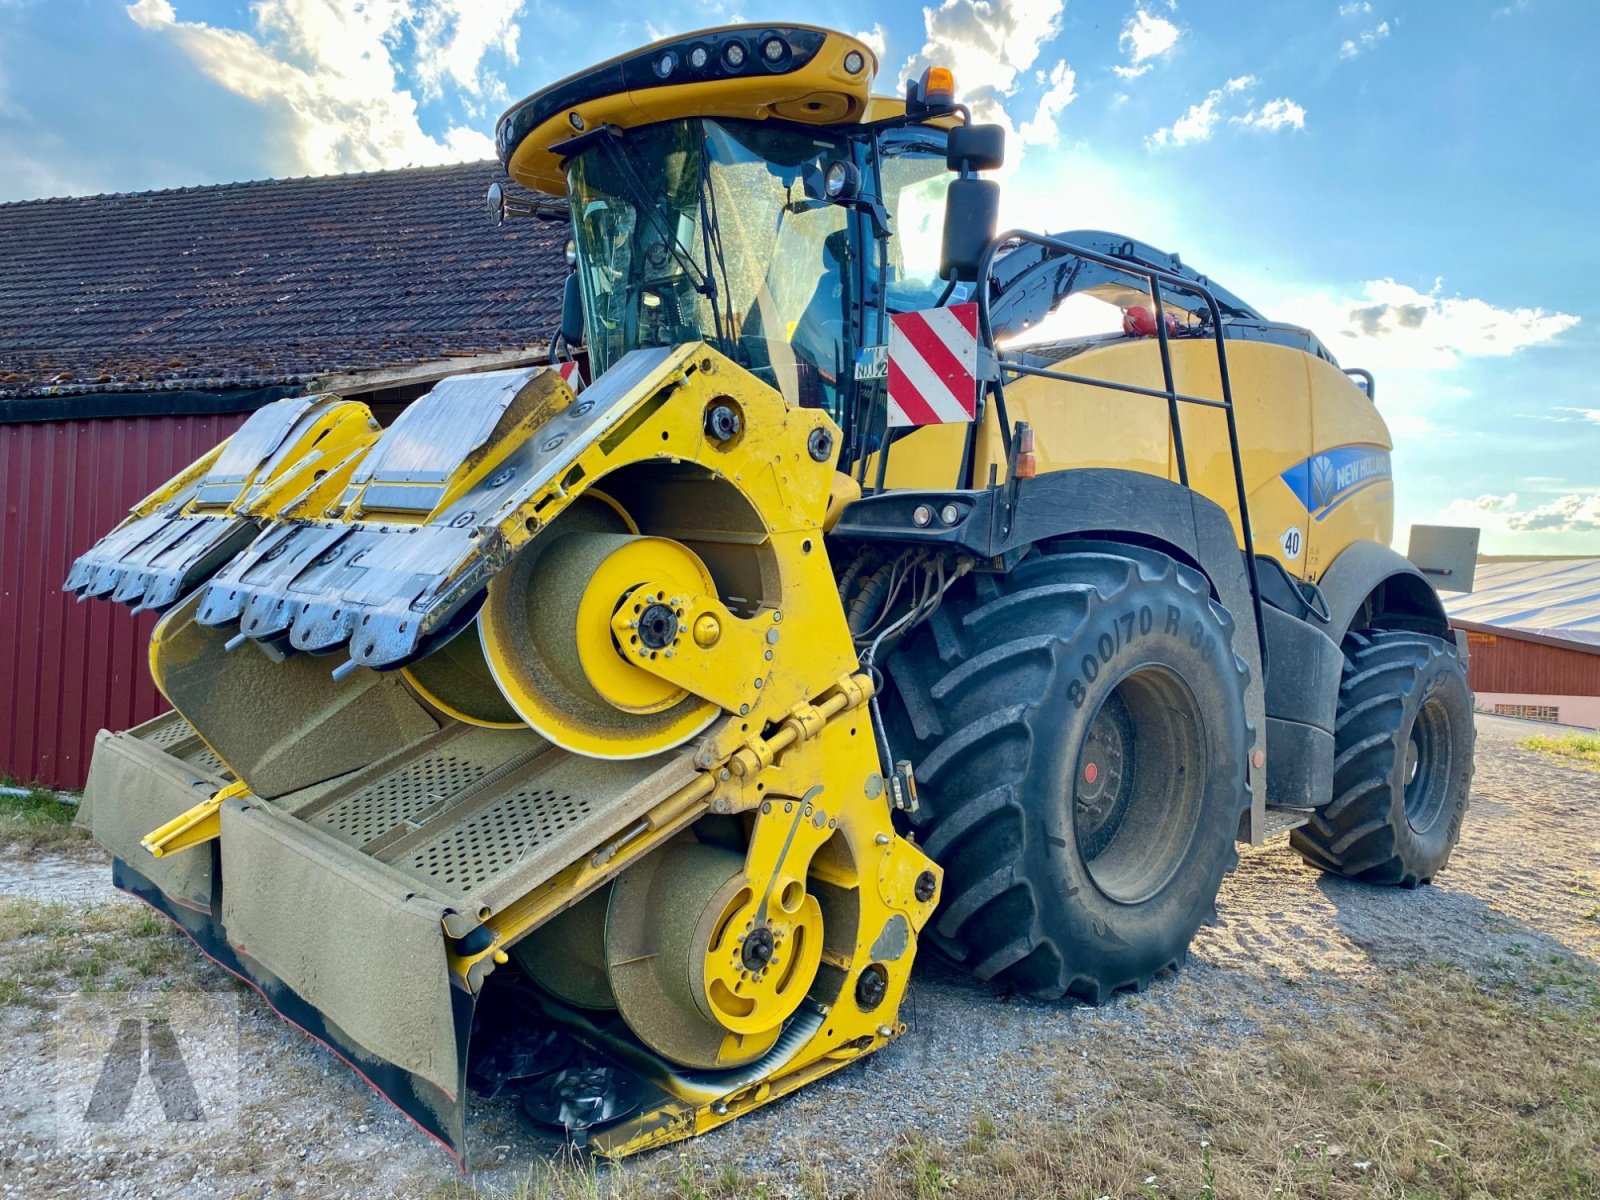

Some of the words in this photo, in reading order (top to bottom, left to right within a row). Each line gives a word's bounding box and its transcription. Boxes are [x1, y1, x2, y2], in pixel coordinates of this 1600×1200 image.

[1336, 460, 1359, 490] NEW
[1284, 532, 1300, 555] 40
[1067, 604, 1153, 710] 800/70
[1164, 604, 1181, 637] R
